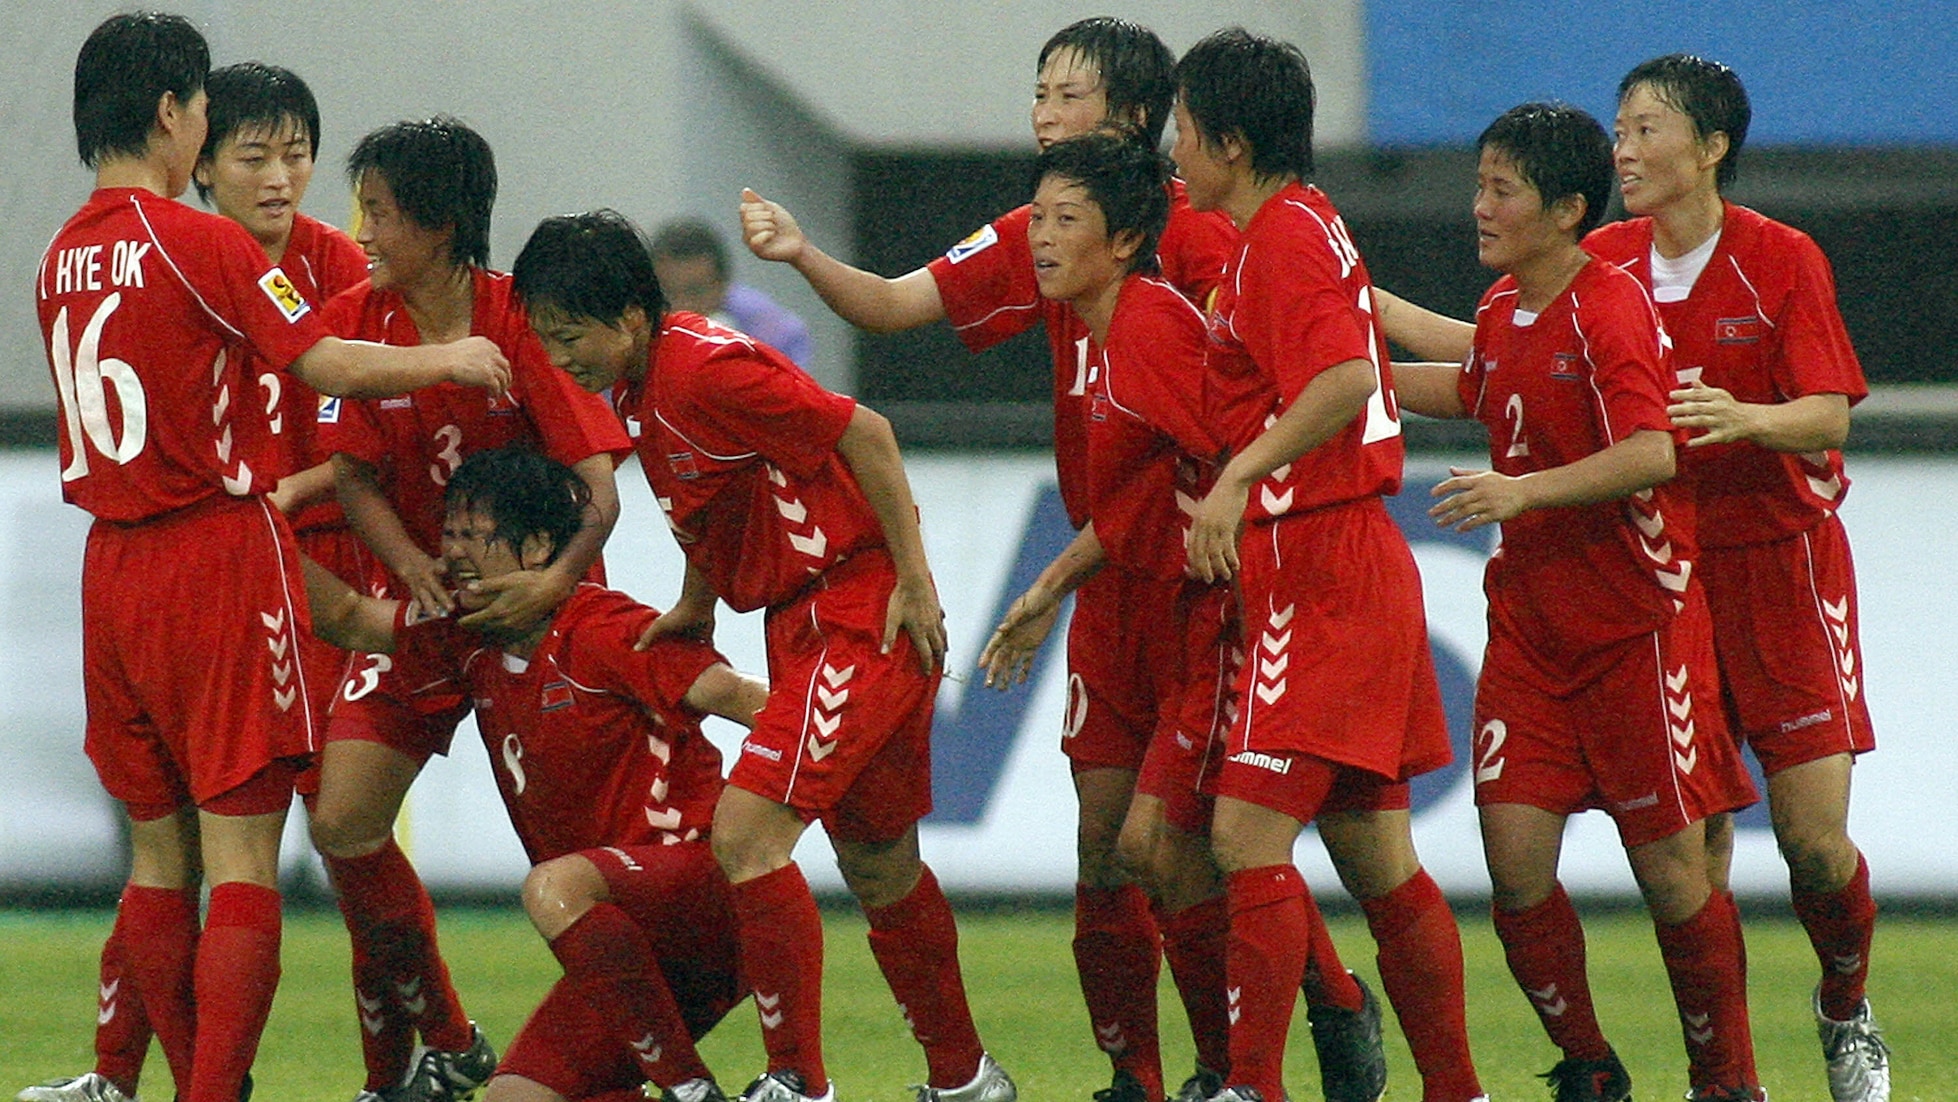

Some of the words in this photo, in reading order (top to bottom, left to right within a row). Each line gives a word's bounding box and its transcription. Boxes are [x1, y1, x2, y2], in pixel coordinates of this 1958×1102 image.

[56, 245, 103, 294] HYE
[112, 240, 152, 288] OK
[52, 291, 147, 483] 16
[430, 424, 462, 487] 3
[1506, 393, 1530, 458] 2
[344, 653, 393, 701] 3
[1476, 719, 1507, 785] 2
